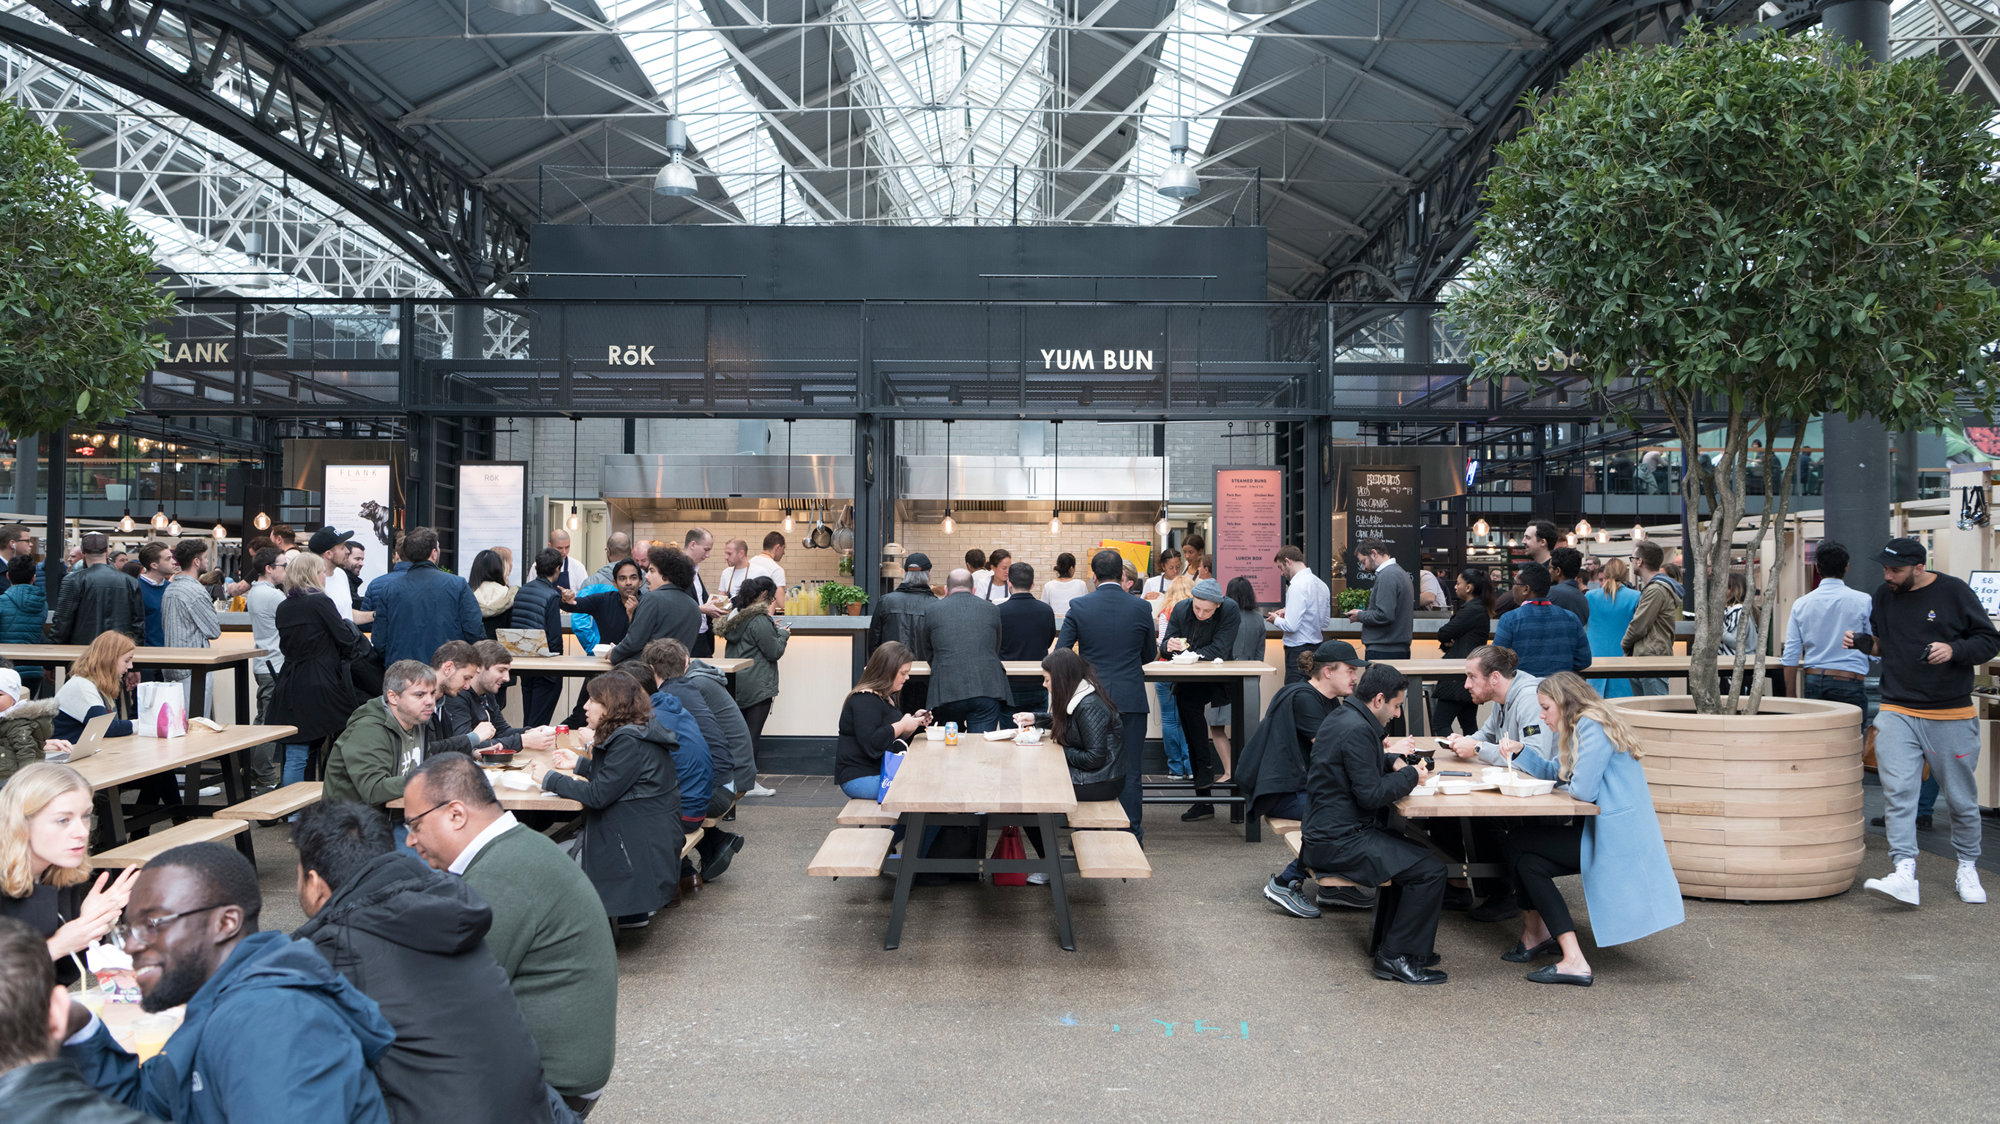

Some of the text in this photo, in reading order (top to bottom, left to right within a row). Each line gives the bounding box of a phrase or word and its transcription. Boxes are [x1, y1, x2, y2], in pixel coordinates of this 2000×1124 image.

[153, 342, 229, 363] LANK
[1040, 349, 1153, 370] YUM BUN
